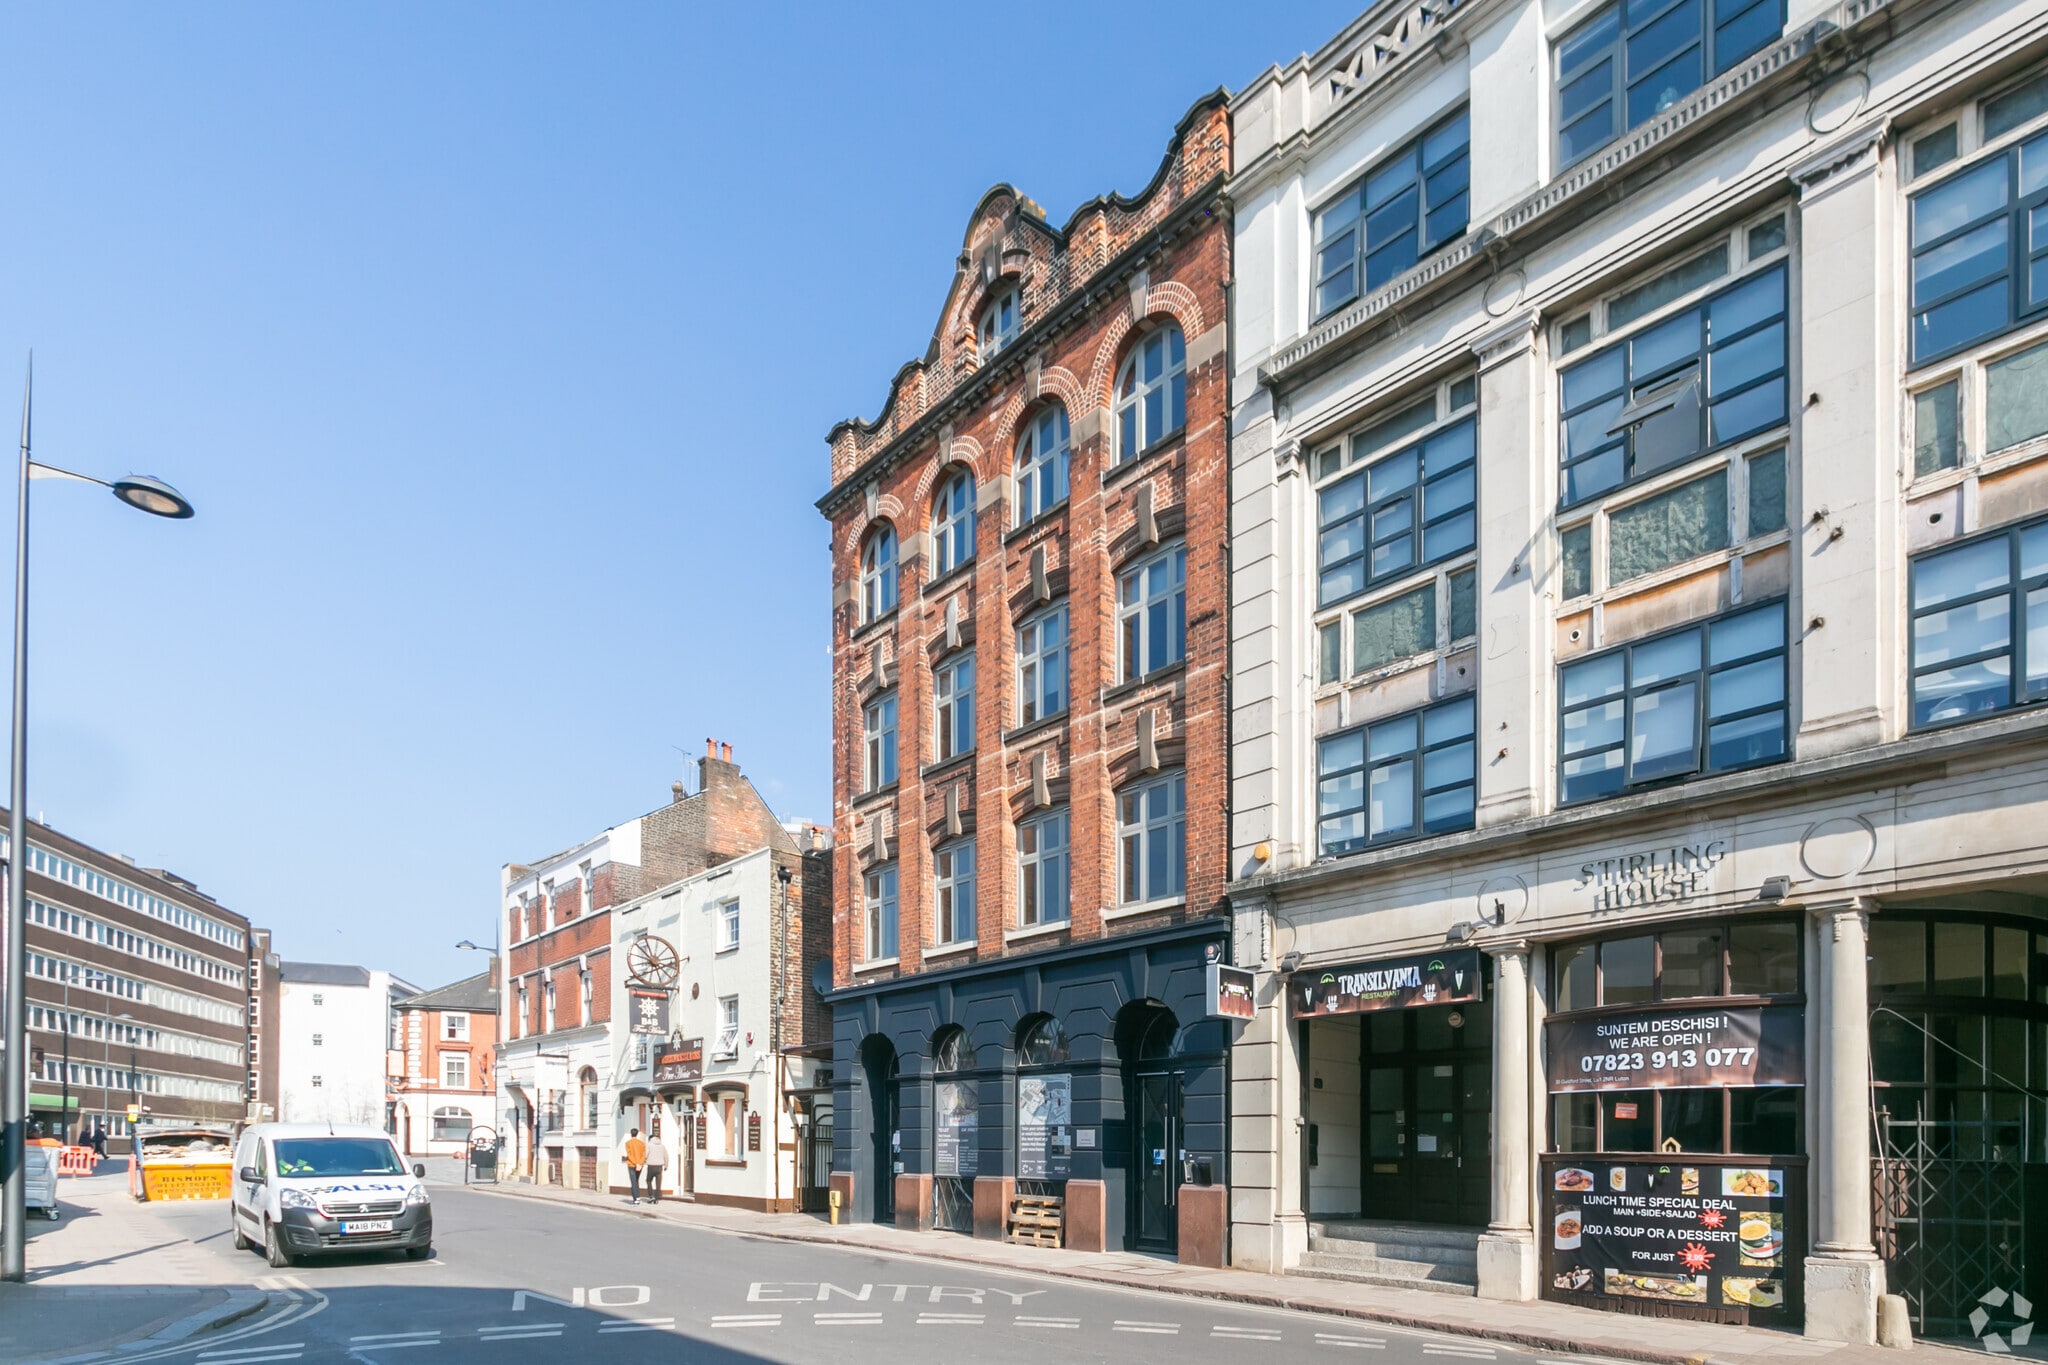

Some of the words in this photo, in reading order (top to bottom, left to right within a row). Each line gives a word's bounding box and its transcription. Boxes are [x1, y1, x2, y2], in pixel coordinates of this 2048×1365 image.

[1581, 841, 1724, 885] STIRLING
[1604, 870, 1709, 908] HOUSE
[1337, 966, 1422, 997] TRANSILVANIA
[1361, 990, 1400, 1000] RESTAURANT
[1597, 1022, 1648, 1036] SUNTEM
[1651, 1018, 1719, 1032] DESCHISI
[1609, 1037, 1629, 1049] WE
[1631, 1036, 1659, 1048] ARE
[1662, 1034, 1703, 1046] OPEN
[1581, 1052, 1645, 1072] 07823
[1651, 1049, 1697, 1069] 913
[1705, 1047, 1755, 1067] 077
[1583, 1195, 1617, 1205] LUNCH
[1618, 1196, 1646, 1207] TIME
[1648, 1197, 1700, 1209] SPECIAL
[1702, 1199, 1737, 1210] DEAL
[1613, 1207, 1634, 1216] MAIN
[349, 1223, 368, 1231] MA18
[370, 1221, 388, 1229] PNZ
[1582, 1224, 1603, 1234] ADD
[1604, 1226, 1613, 1235] A
[1613, 1226, 1646, 1237] SOUP
[1646, 1228, 1665, 1238] OR
[1666, 1229, 1676, 1239] A
[1677, 1229, 1738, 1242] DESSERT
[1632, 1251, 1650, 1260] FOR
[1651, 1253, 1675, 1262] JUST
[512, 1284, 651, 1311] NO
[747, 1281, 1047, 1305] ENTRY
